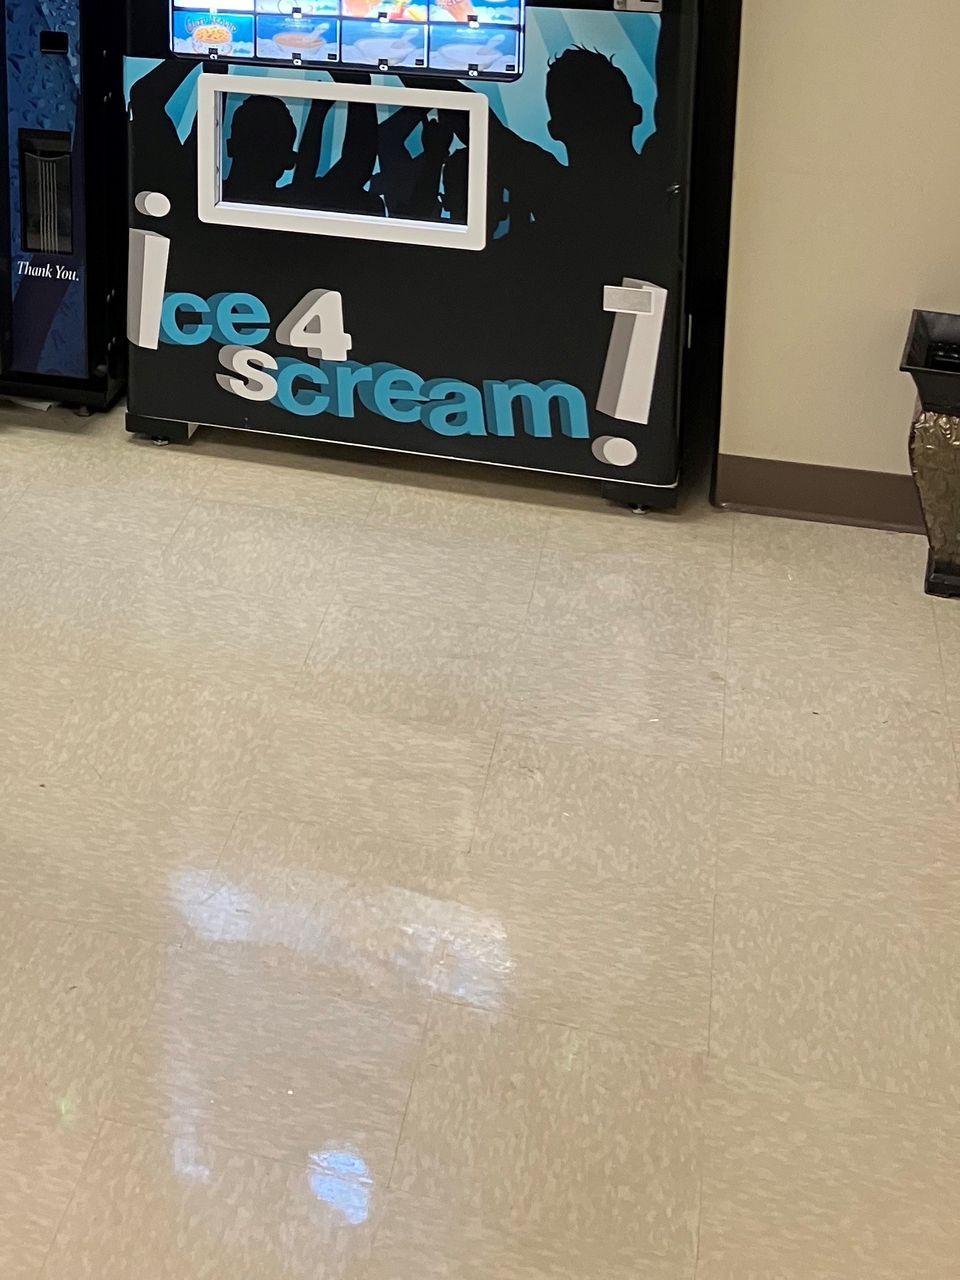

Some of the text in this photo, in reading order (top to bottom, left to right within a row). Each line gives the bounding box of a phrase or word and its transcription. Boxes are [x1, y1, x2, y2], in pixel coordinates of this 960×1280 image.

[17, 261, 80, 281] Thank You.
[275, 288, 352, 361] 4
